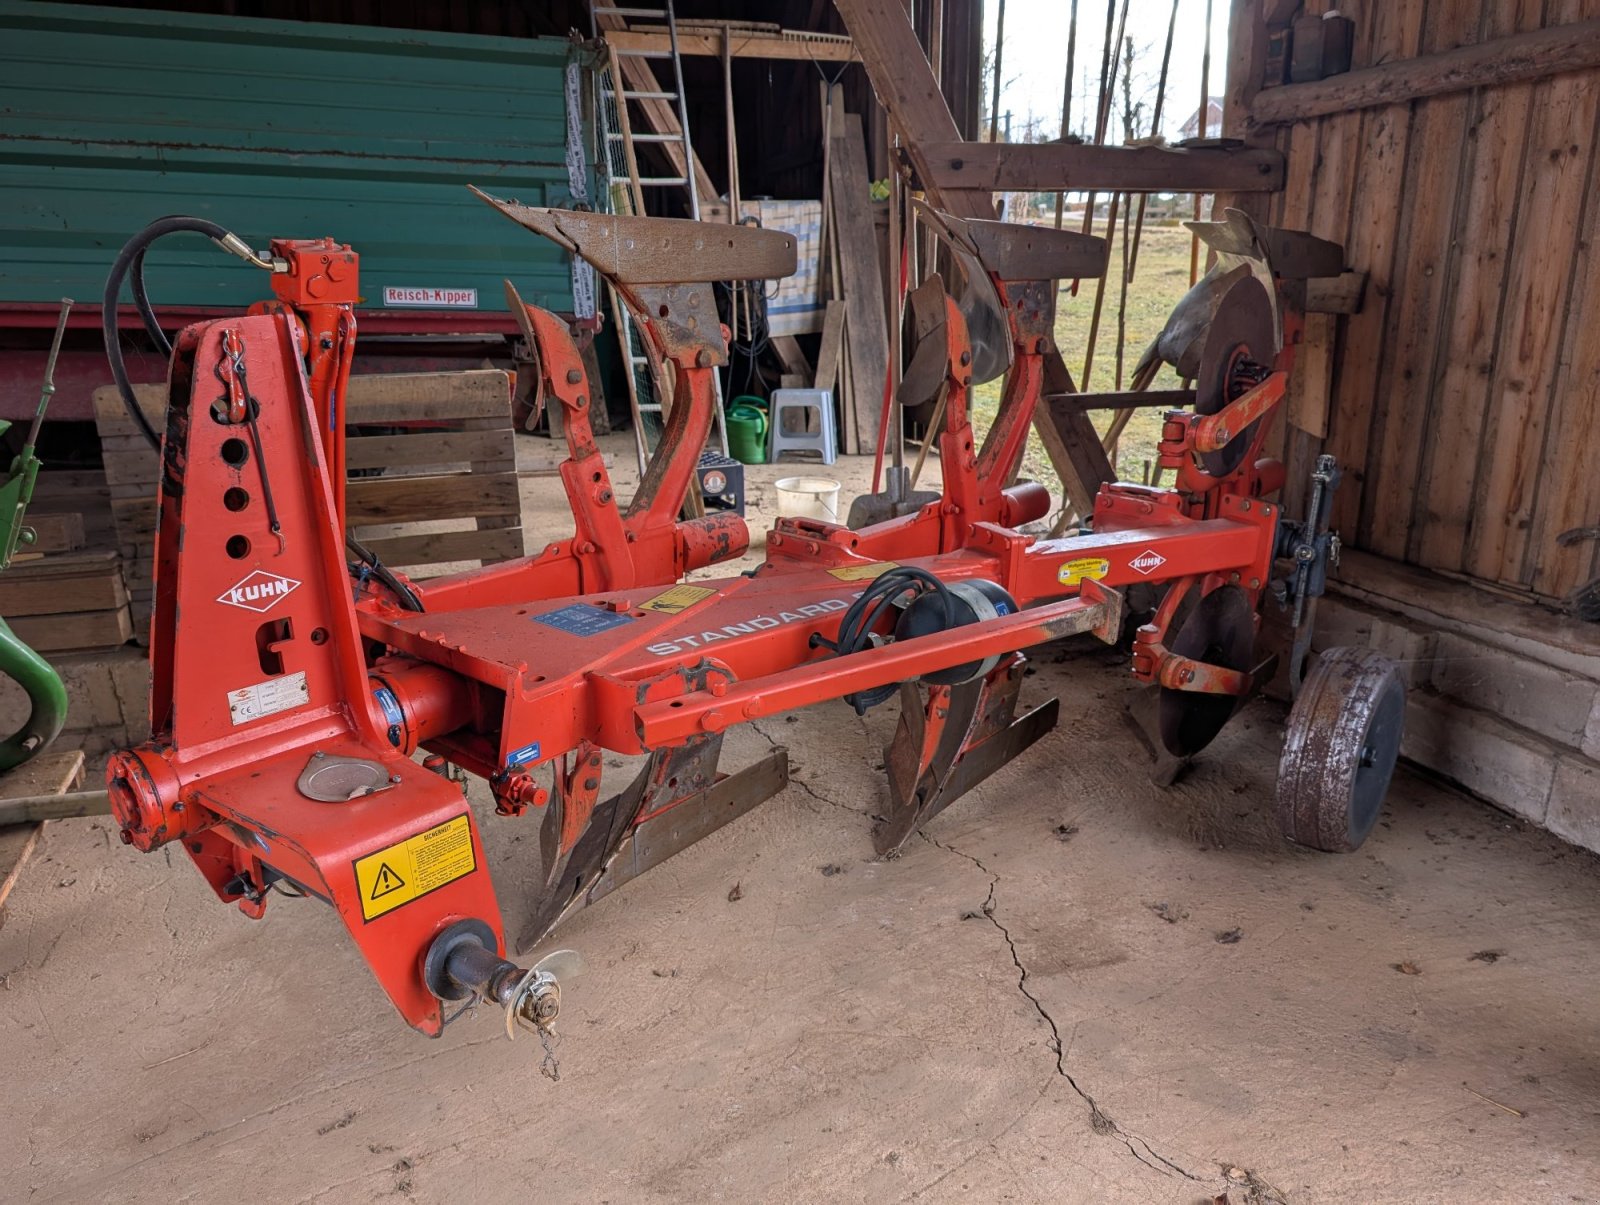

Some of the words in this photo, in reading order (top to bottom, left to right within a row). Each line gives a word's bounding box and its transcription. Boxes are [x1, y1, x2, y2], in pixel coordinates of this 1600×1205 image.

[388, 288, 473, 304] Reisch-Kipper
[1134, 557, 1161, 568] KUHN
[231, 579, 289, 604] KUHN
[646, 599, 849, 656] STANDARD
